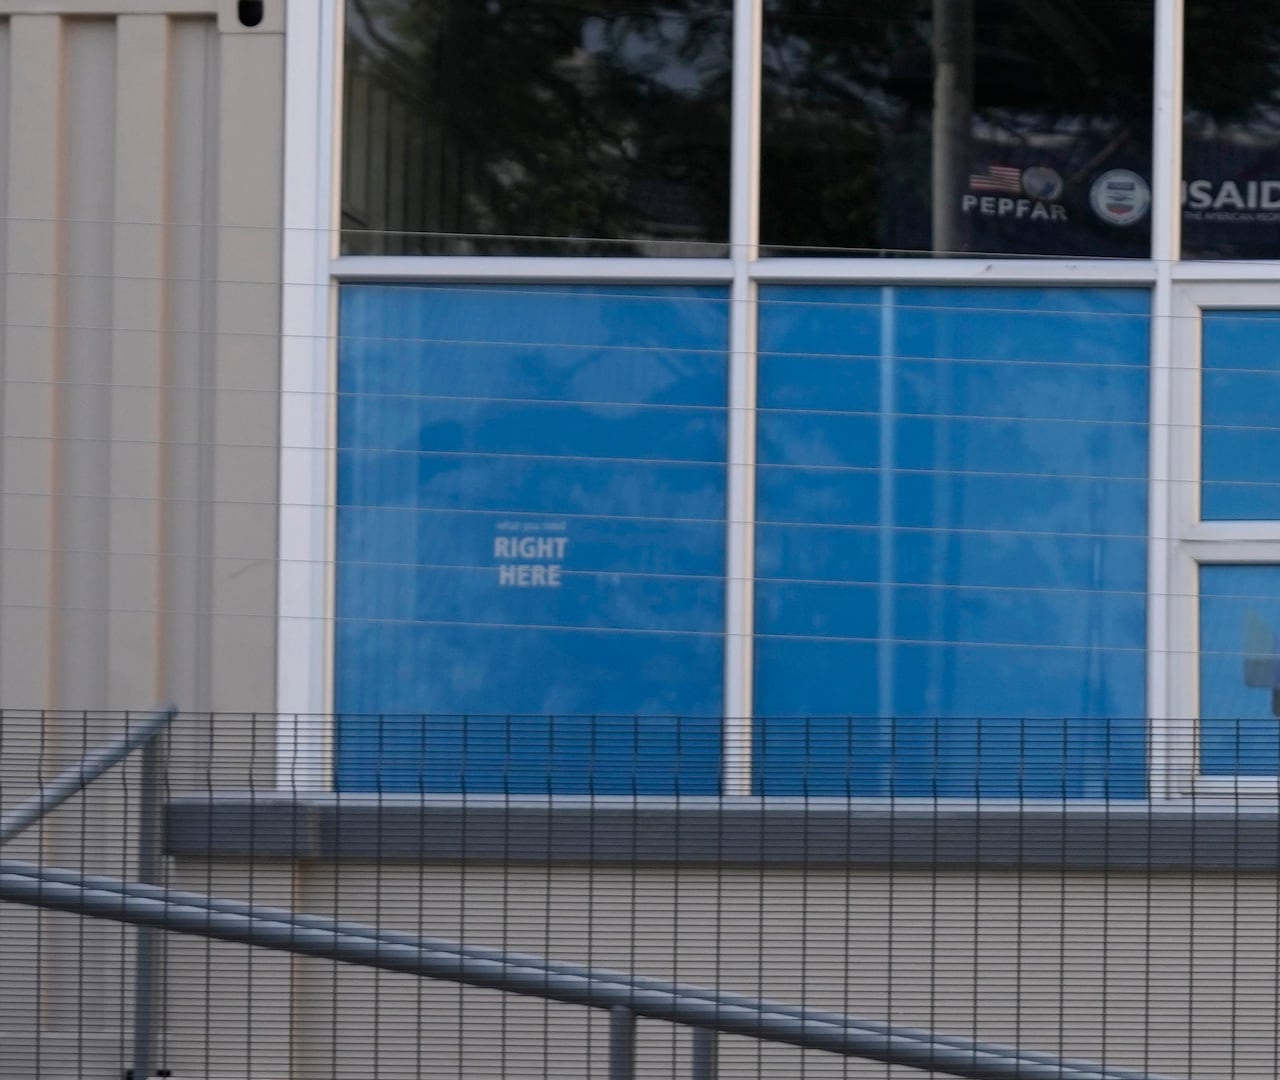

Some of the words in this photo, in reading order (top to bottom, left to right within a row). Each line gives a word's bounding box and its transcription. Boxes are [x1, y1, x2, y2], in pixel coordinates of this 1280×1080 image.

[961, 194, 1068, 222] PEPFAR
[494, 536, 569, 560] RIGHT
[499, 564, 562, 588] HERE
